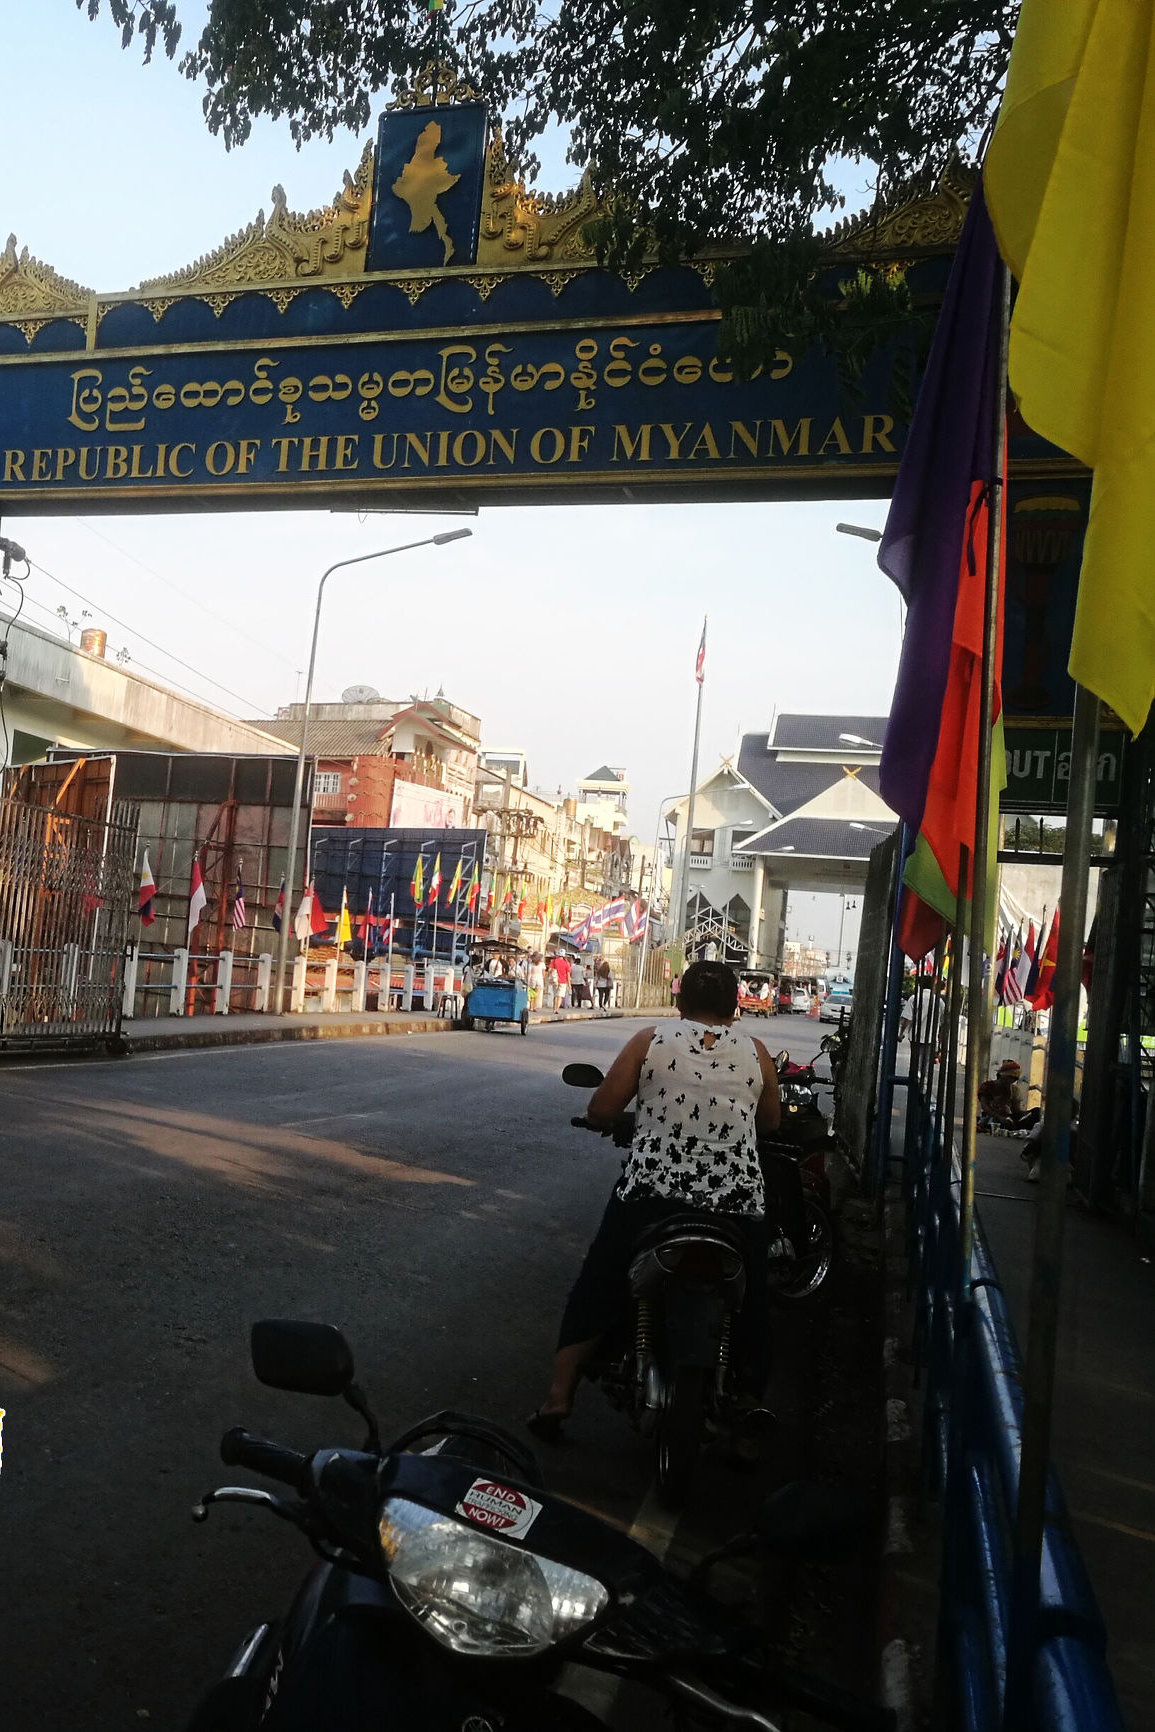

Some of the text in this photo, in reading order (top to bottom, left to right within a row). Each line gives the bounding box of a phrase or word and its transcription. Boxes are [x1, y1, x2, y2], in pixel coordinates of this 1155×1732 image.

[1, 414, 898, 483] REPUBLIC OF THE UNION OF MYANMAR
[469, 1491, 523, 1516] HUMAN
[485, 1486, 516, 1503] END
[467, 1507, 506, 1527] NOW!
